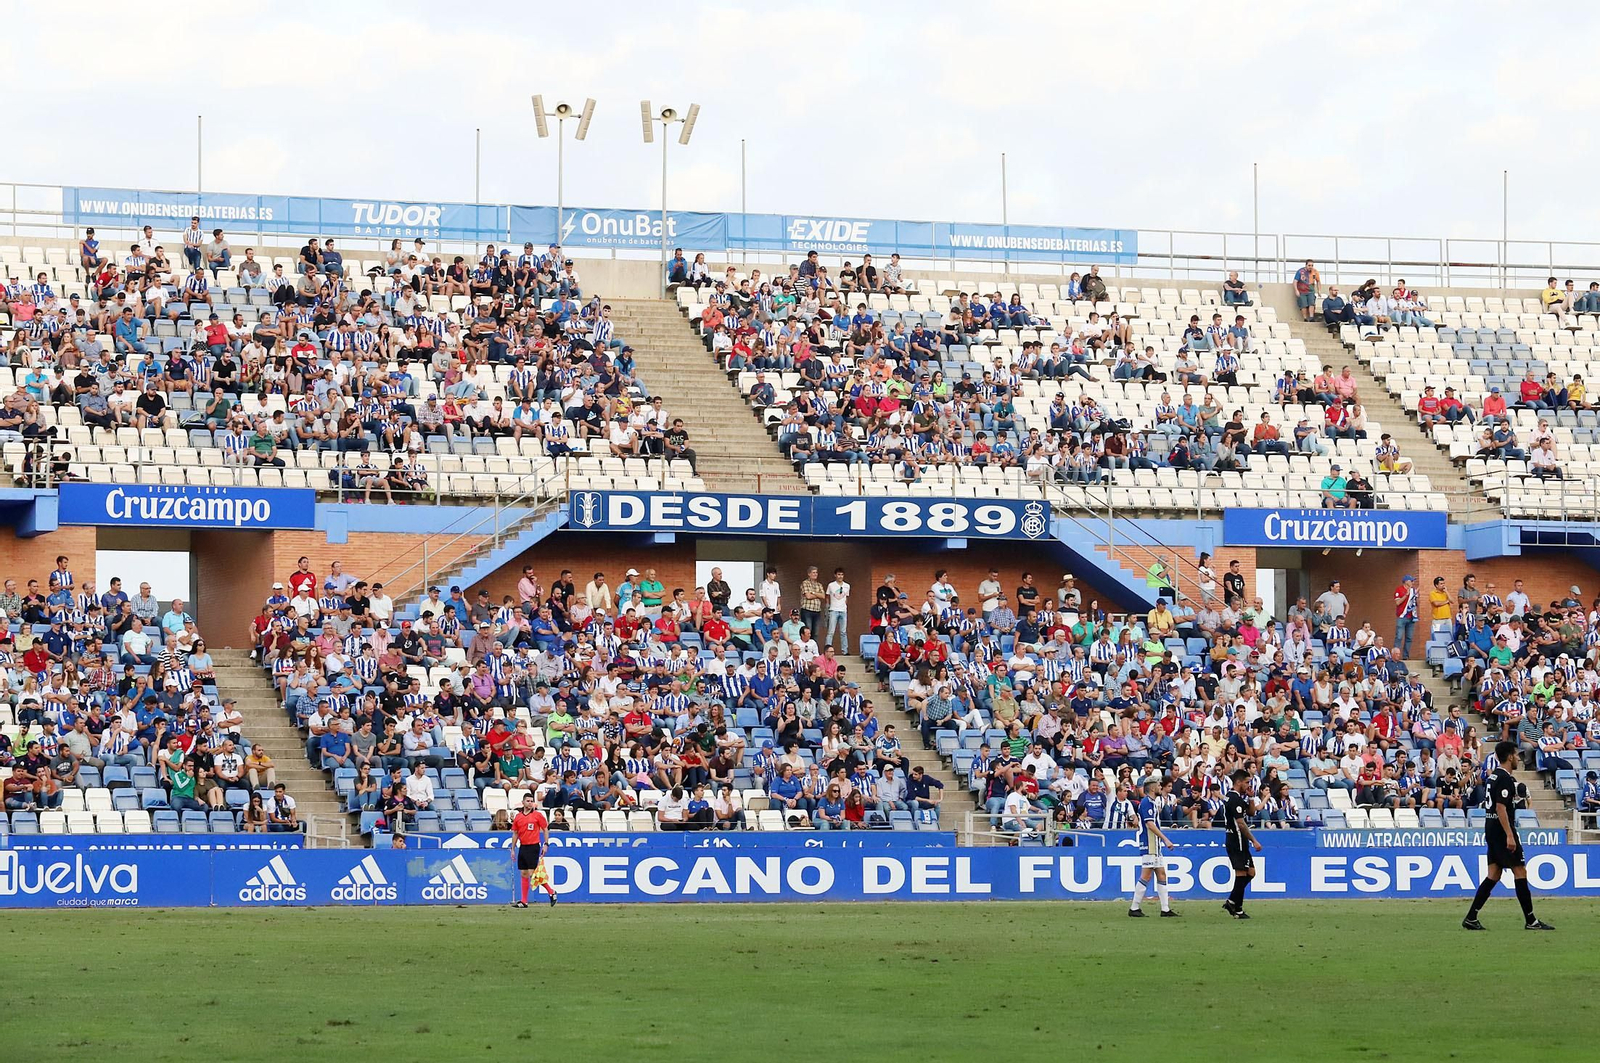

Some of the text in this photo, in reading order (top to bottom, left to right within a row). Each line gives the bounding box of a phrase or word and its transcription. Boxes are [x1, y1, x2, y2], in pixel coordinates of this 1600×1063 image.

[79, 199, 273, 221] WWW.ONUBENSEDEBATERIAS.ES
[352, 203, 442, 227] TUDOR
[354, 226, 440, 237] BATTERIES
[581, 212, 677, 237] OnuBat
[787, 219, 871, 243] EXIDE
[586, 236, 675, 246] onubense de bateras
[792, 241, 869, 252] TECHNOLOGIES
[949, 234, 1123, 253] WWW.ONUBENSEDEBATERIAS.ES
[105, 487, 271, 526] Cruzcampo
[608, 494, 1017, 535] DESDE 1889
[1264, 511, 1408, 546] Cruzcampo
[539, 856, 836, 895] DECANO
[862, 856, 992, 894] DEL
[1019, 856, 1287, 893] FUTBOL
[107, 897, 139, 906] marca
[238, 884, 307, 902] adidas
[330, 884, 398, 902] adidas
[421, 884, 488, 901] adidas
